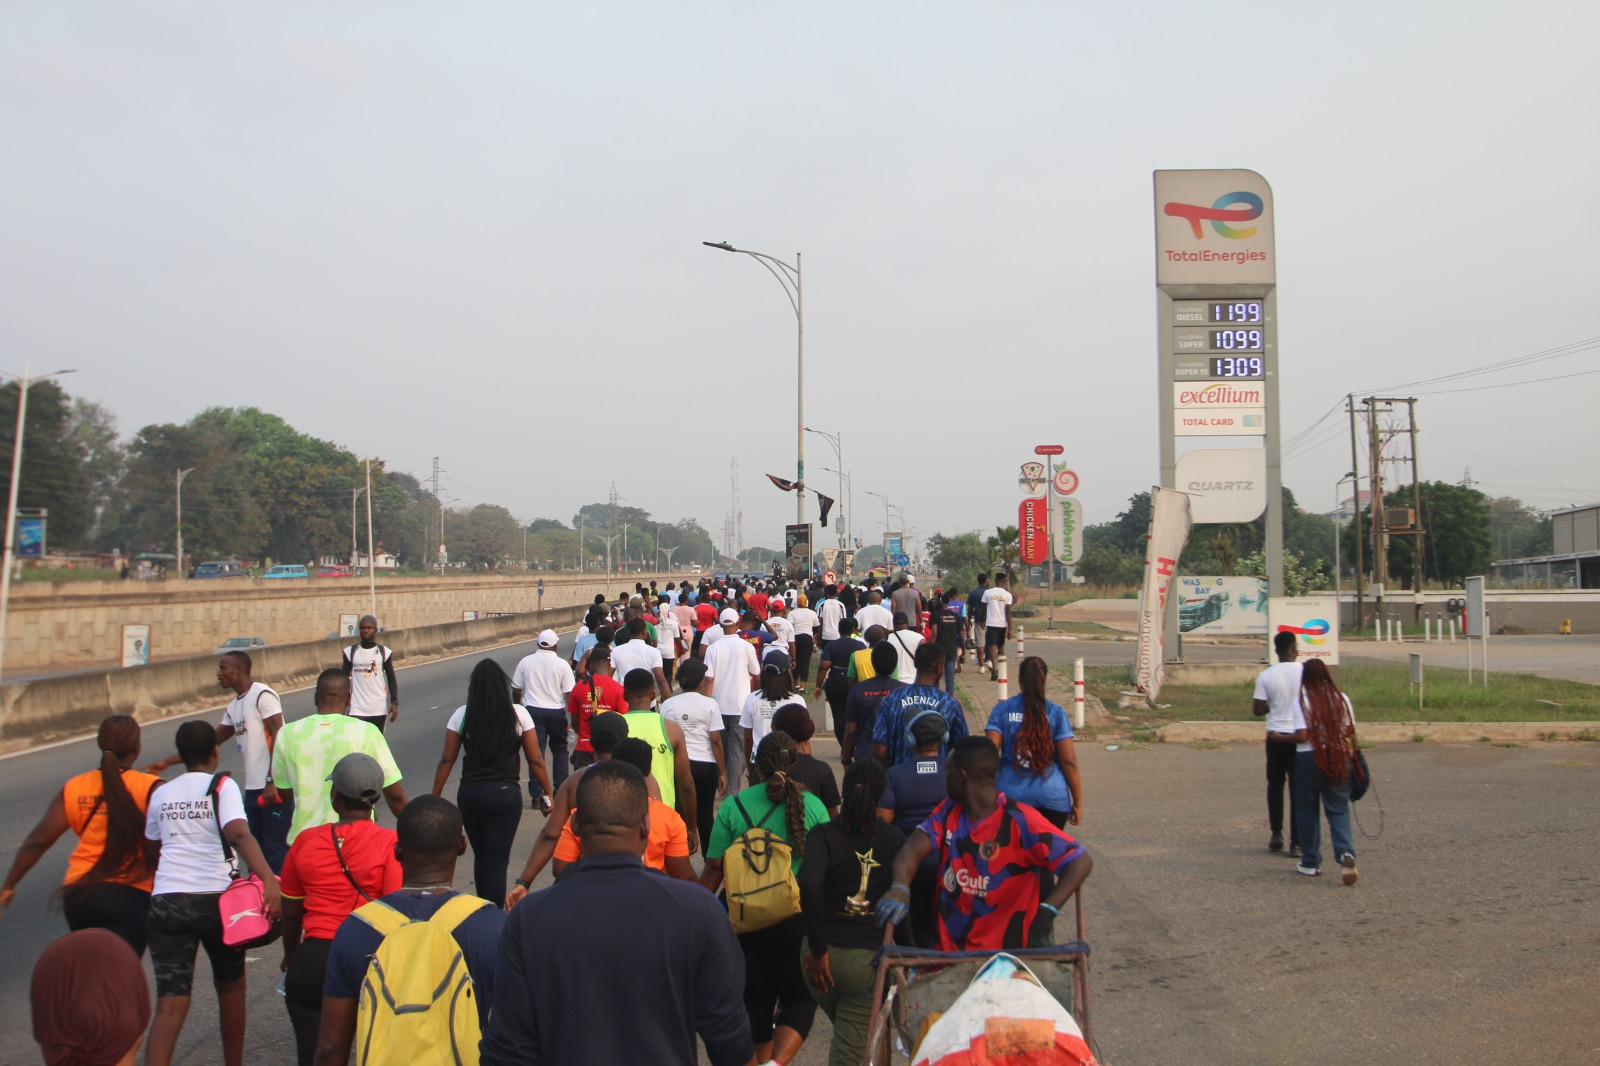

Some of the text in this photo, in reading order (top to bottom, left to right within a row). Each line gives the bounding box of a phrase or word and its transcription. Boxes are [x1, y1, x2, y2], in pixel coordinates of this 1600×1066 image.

[1165, 249, 1266, 264] TotalEnergies
[1215, 303, 1260, 322] 1199
[1216, 330, 1261, 349] 1099
[1174, 368, 1198, 376] SUPER
[1216, 357, 1262, 377] 1309
[1179, 387, 1260, 404] excellium
[1182, 418, 1234, 426] TOTAL CARD
[1188, 481, 1254, 491] QUARTZ
[1025, 501, 1035, 560] CHICKEN MAN
[1060, 500, 1075, 561] pinkberry
[901, 695, 940, 708] ADENIJI
[161, 801, 209, 811] CATCH ME
[166, 811, 186, 820] YOU
[187, 810, 214, 820] CAN!
[956, 868, 990, 890] Gulf
[962, 886, 988, 897] energy
